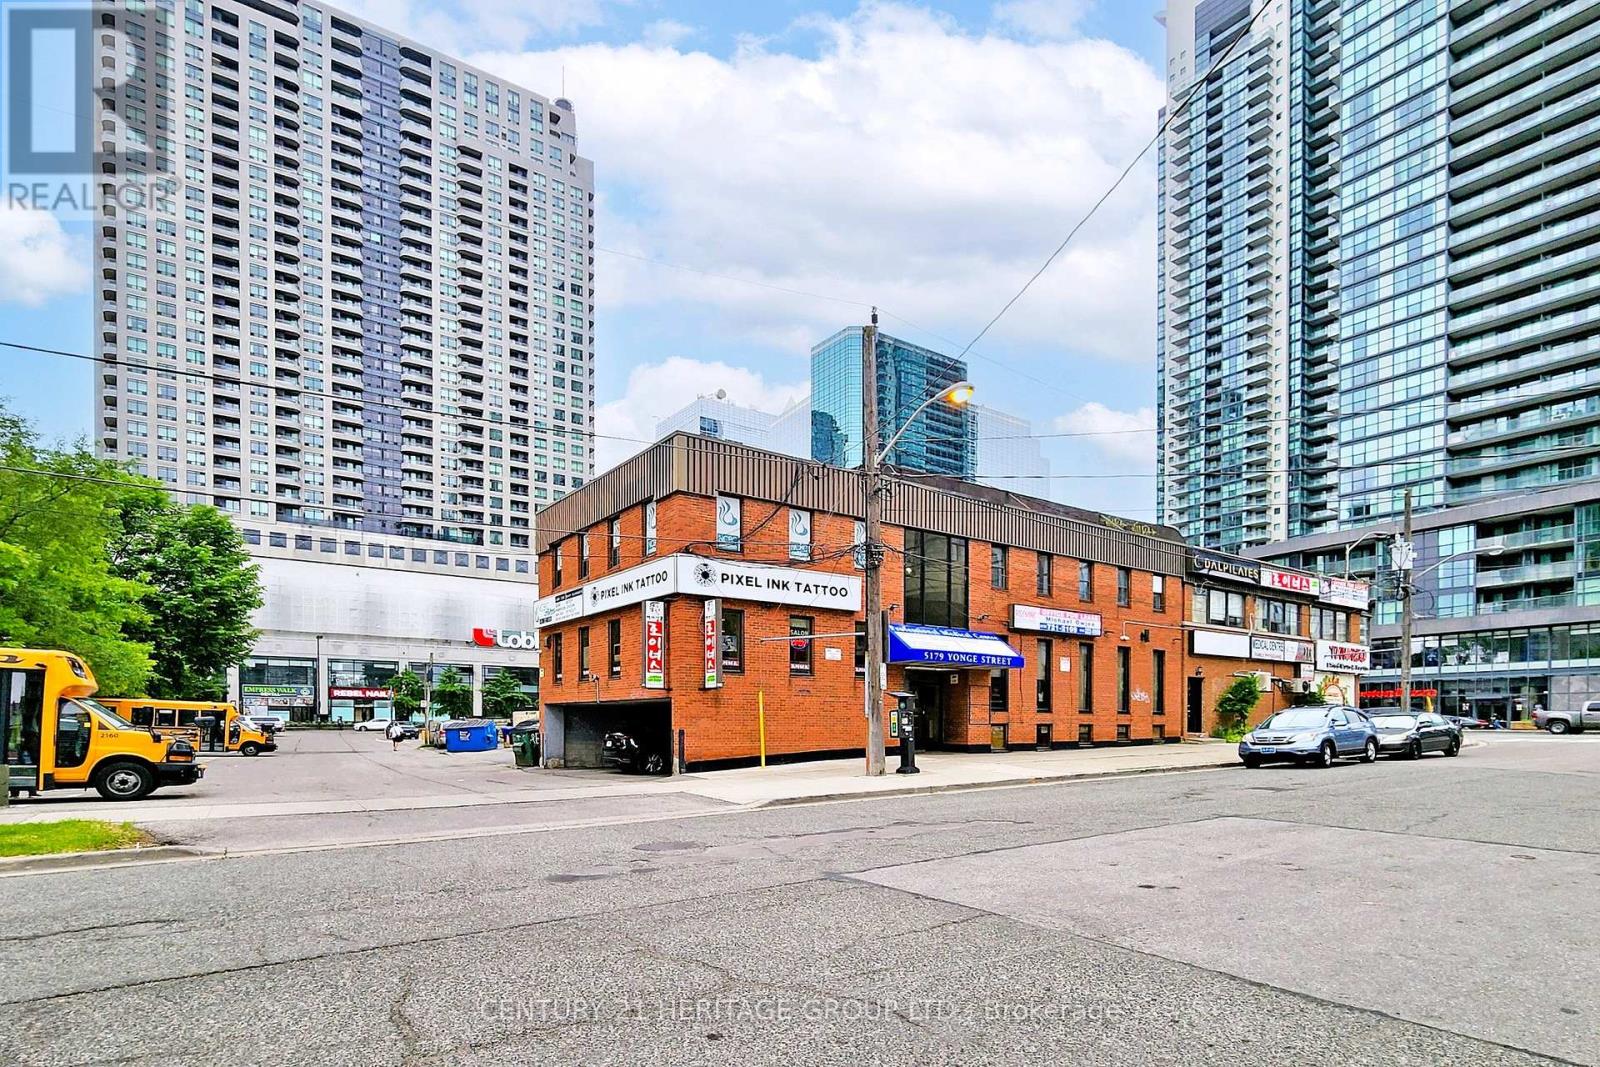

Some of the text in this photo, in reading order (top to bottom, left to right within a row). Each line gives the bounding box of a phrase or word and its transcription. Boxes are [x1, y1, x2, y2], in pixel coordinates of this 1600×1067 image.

[1204, 558, 1259, 580] DALPILATES
[601, 570, 668, 600] PIXEL INK TATTOO
[721, 573, 848, 597] PIXEL INK TATTOO
[924, 652, 1012, 666] 5179 YONGE STREET
[334, 688, 365, 698] REBEL
